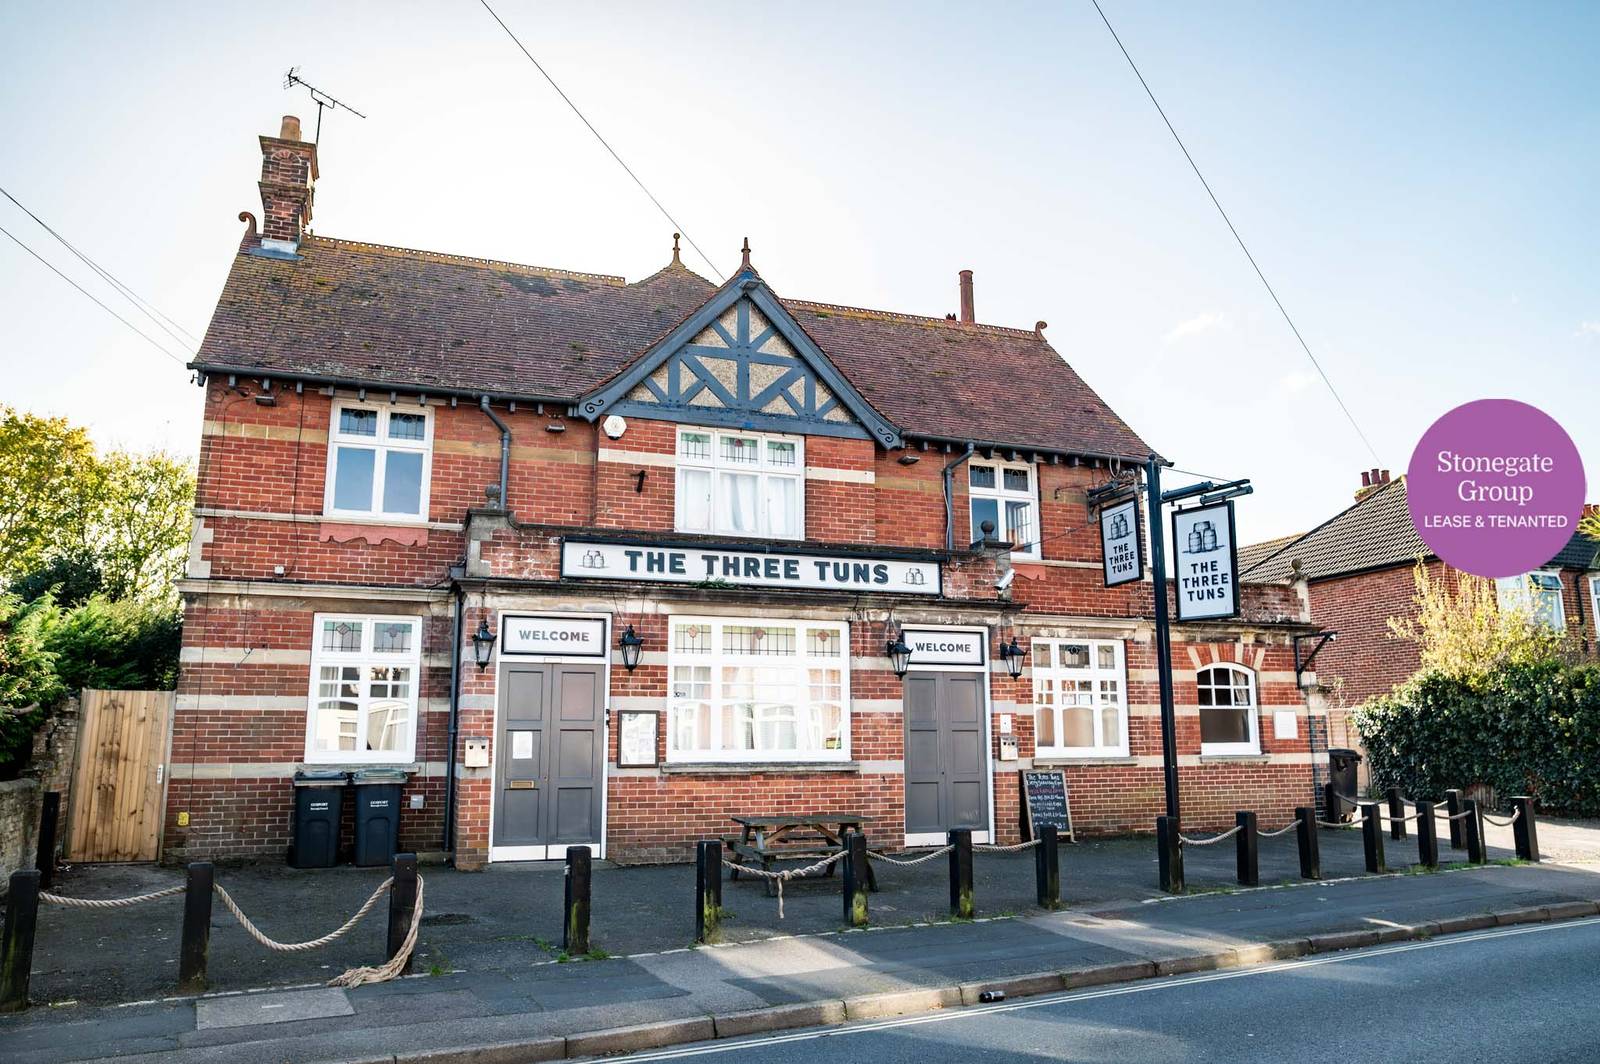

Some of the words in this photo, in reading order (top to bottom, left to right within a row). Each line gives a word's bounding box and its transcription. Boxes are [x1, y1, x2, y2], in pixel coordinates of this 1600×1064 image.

[1113, 543, 1129, 554] THE
[1109, 551, 1135, 565] THREE
[624, 550, 686, 573] THE
[701, 554, 800, 579] THREE
[814, 560, 889, 585] TUNS
[1112, 561, 1133, 574] TUNS
[1191, 560, 1218, 574] THE
[1182, 573, 1229, 588] THREE
[1187, 587, 1225, 601] TUNS
[519, 629, 590, 643] WELCOME
[915, 642, 972, 654] WELCOME
